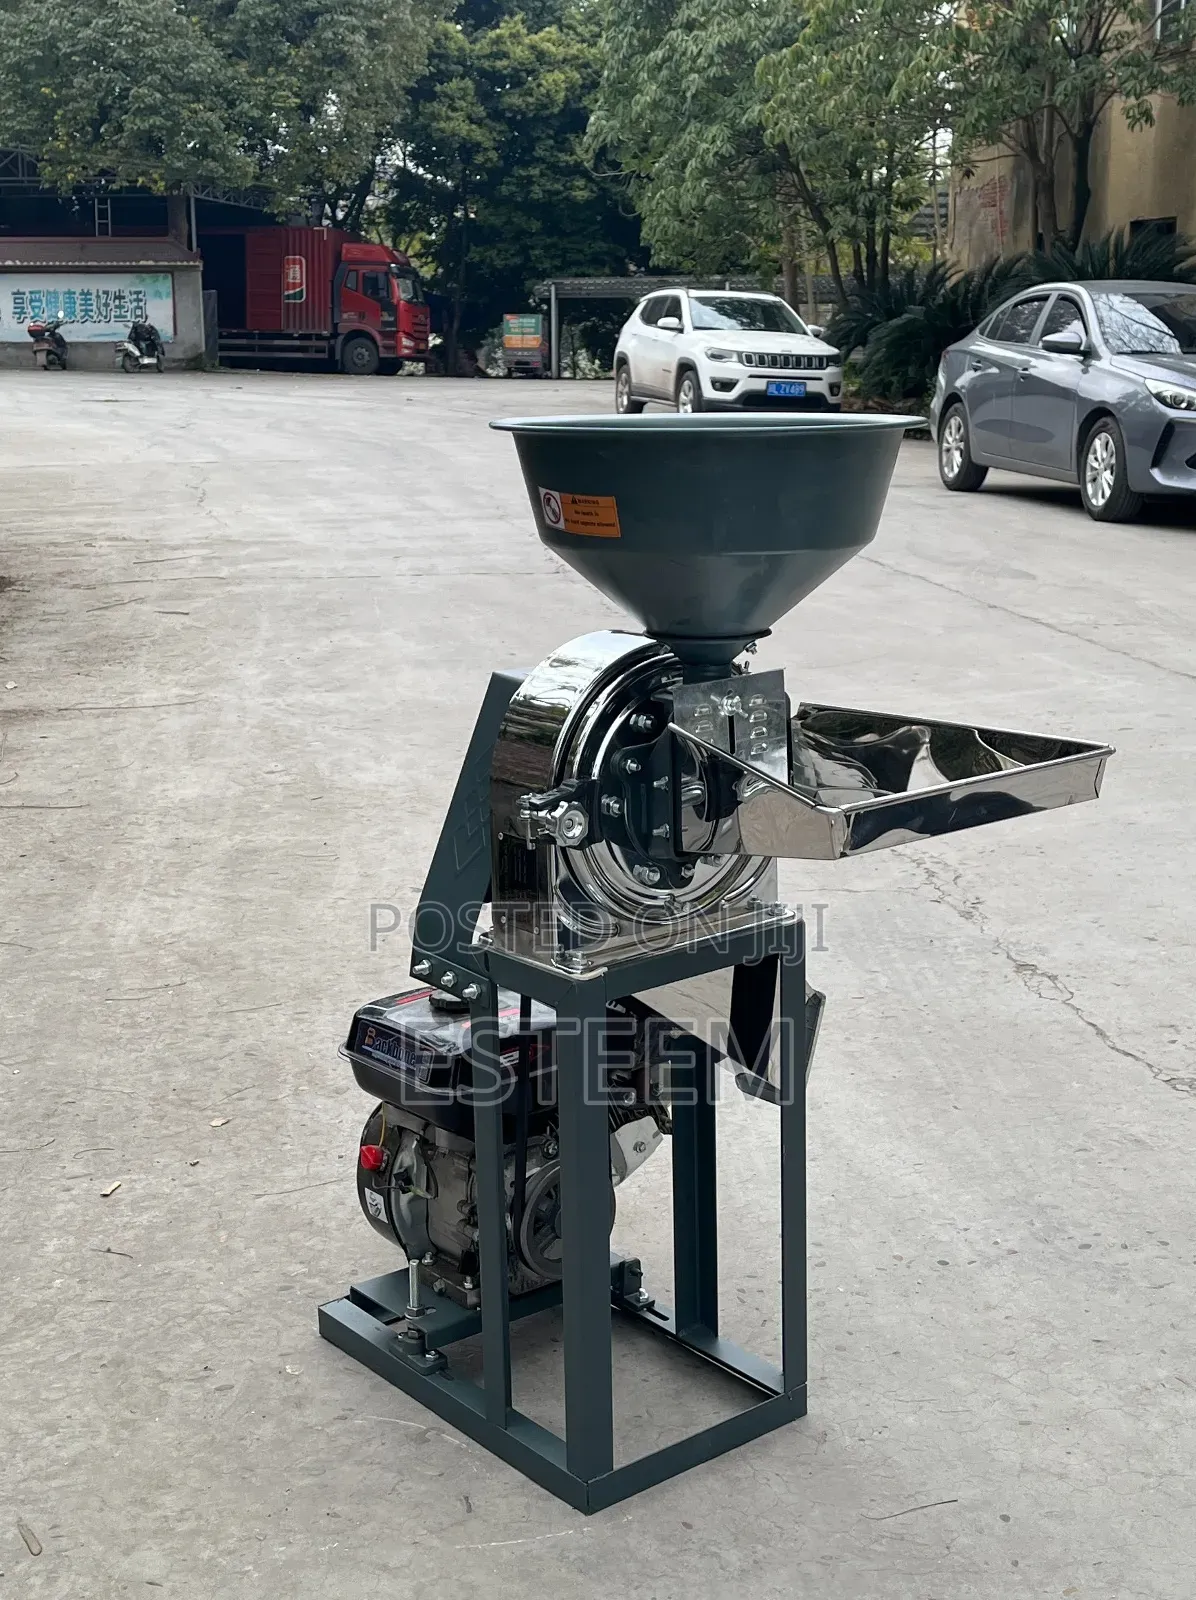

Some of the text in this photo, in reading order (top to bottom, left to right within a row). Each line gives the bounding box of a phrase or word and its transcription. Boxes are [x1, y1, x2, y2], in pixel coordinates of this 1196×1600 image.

[11, 289, 148, 324] 享受健康美好生活
